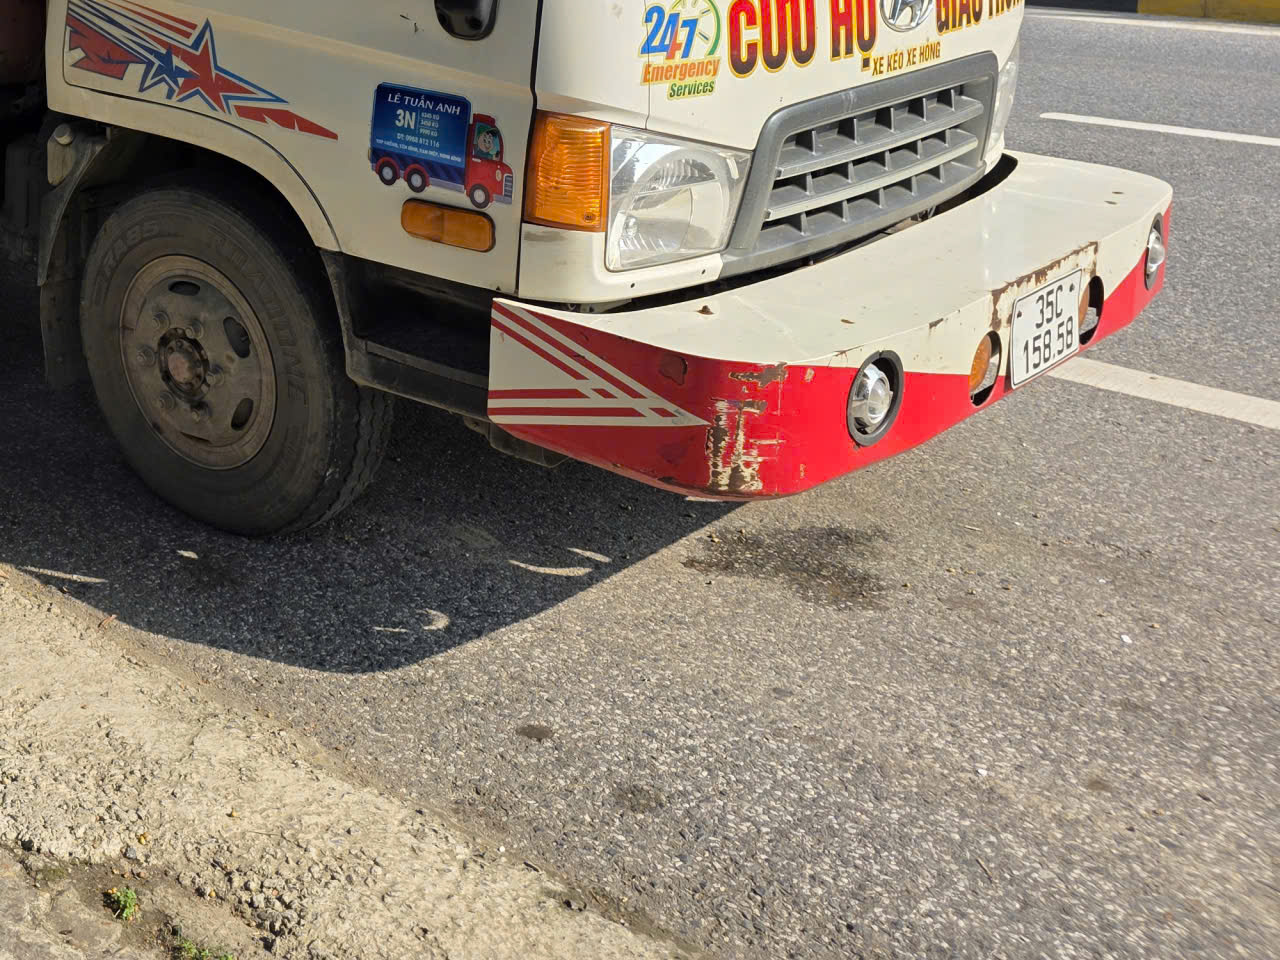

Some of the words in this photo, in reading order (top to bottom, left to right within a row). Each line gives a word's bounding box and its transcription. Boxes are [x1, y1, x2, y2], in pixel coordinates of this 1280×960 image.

[642, 58, 721, 83] Emergency
[872, 56, 884, 76] XE
[887, 49, 904, 72] KÉO
[906, 47, 917, 66] XE
[670, 80, 715, 98] Services
[387, 93, 401, 104] LÊ
[404, 94, 434, 110] TUẤN
[436, 103, 461, 116] ANH
[395, 108, 416, 130] 3N
[1035, 284, 1063, 329] 35C
[1023, 315, 1074, 374] 158.58
